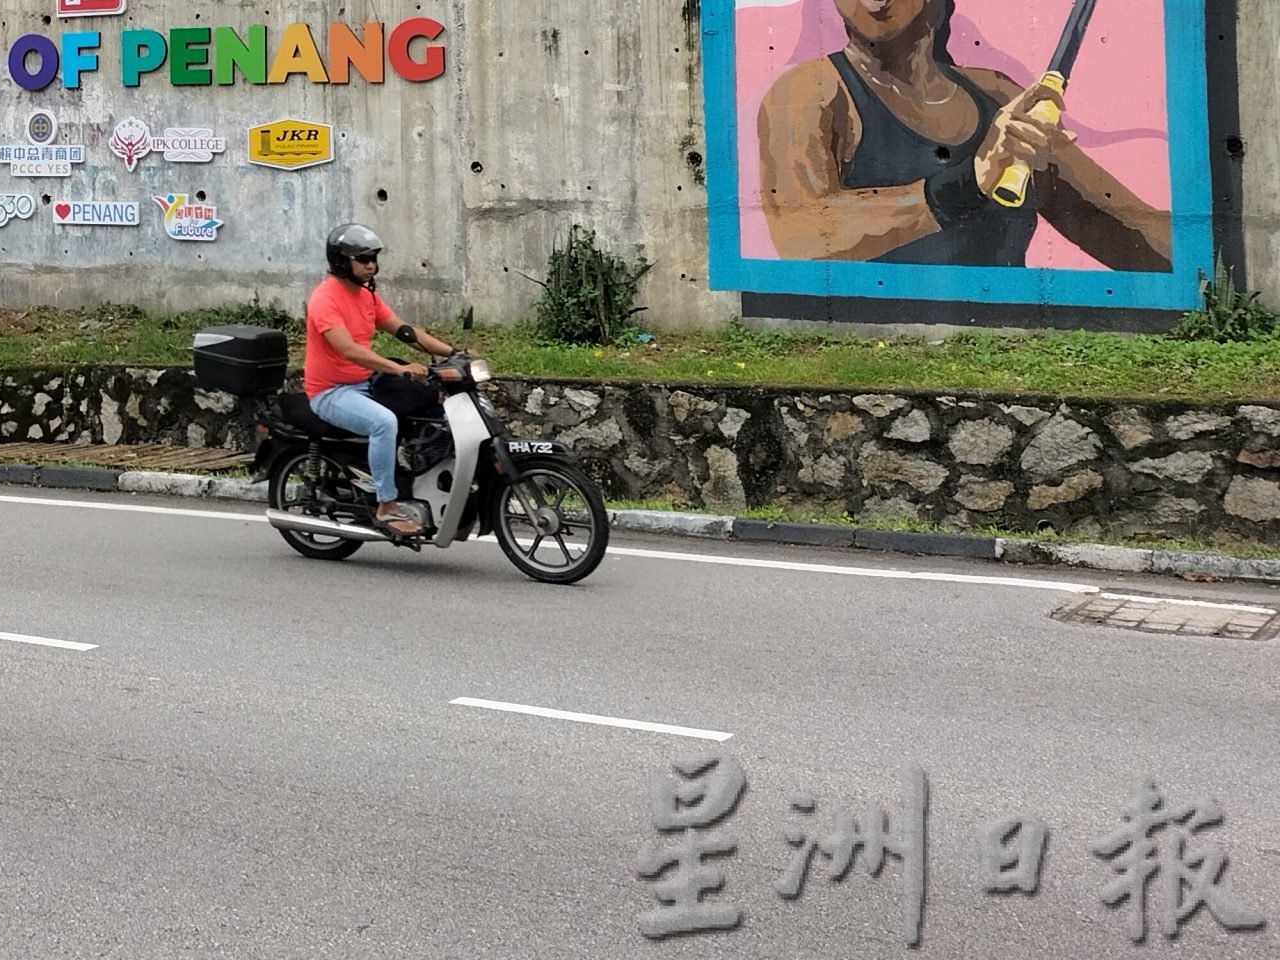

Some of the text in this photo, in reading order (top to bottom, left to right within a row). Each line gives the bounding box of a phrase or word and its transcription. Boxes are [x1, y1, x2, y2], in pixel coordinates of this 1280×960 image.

[8, 31, 100, 91] OF
[121, 17, 446, 87] PENANG
[276, 129, 319, 142] JKR
[153, 138, 222, 150] IPK COLLEGE
[0, 147, 81, 161] 槟中总青商团
[12, 164, 68, 174] PCCC YES
[72, 203, 136, 223] PENANG
[175, 223, 214, 237] Future
[508, 441, 553, 453] PHA 732
